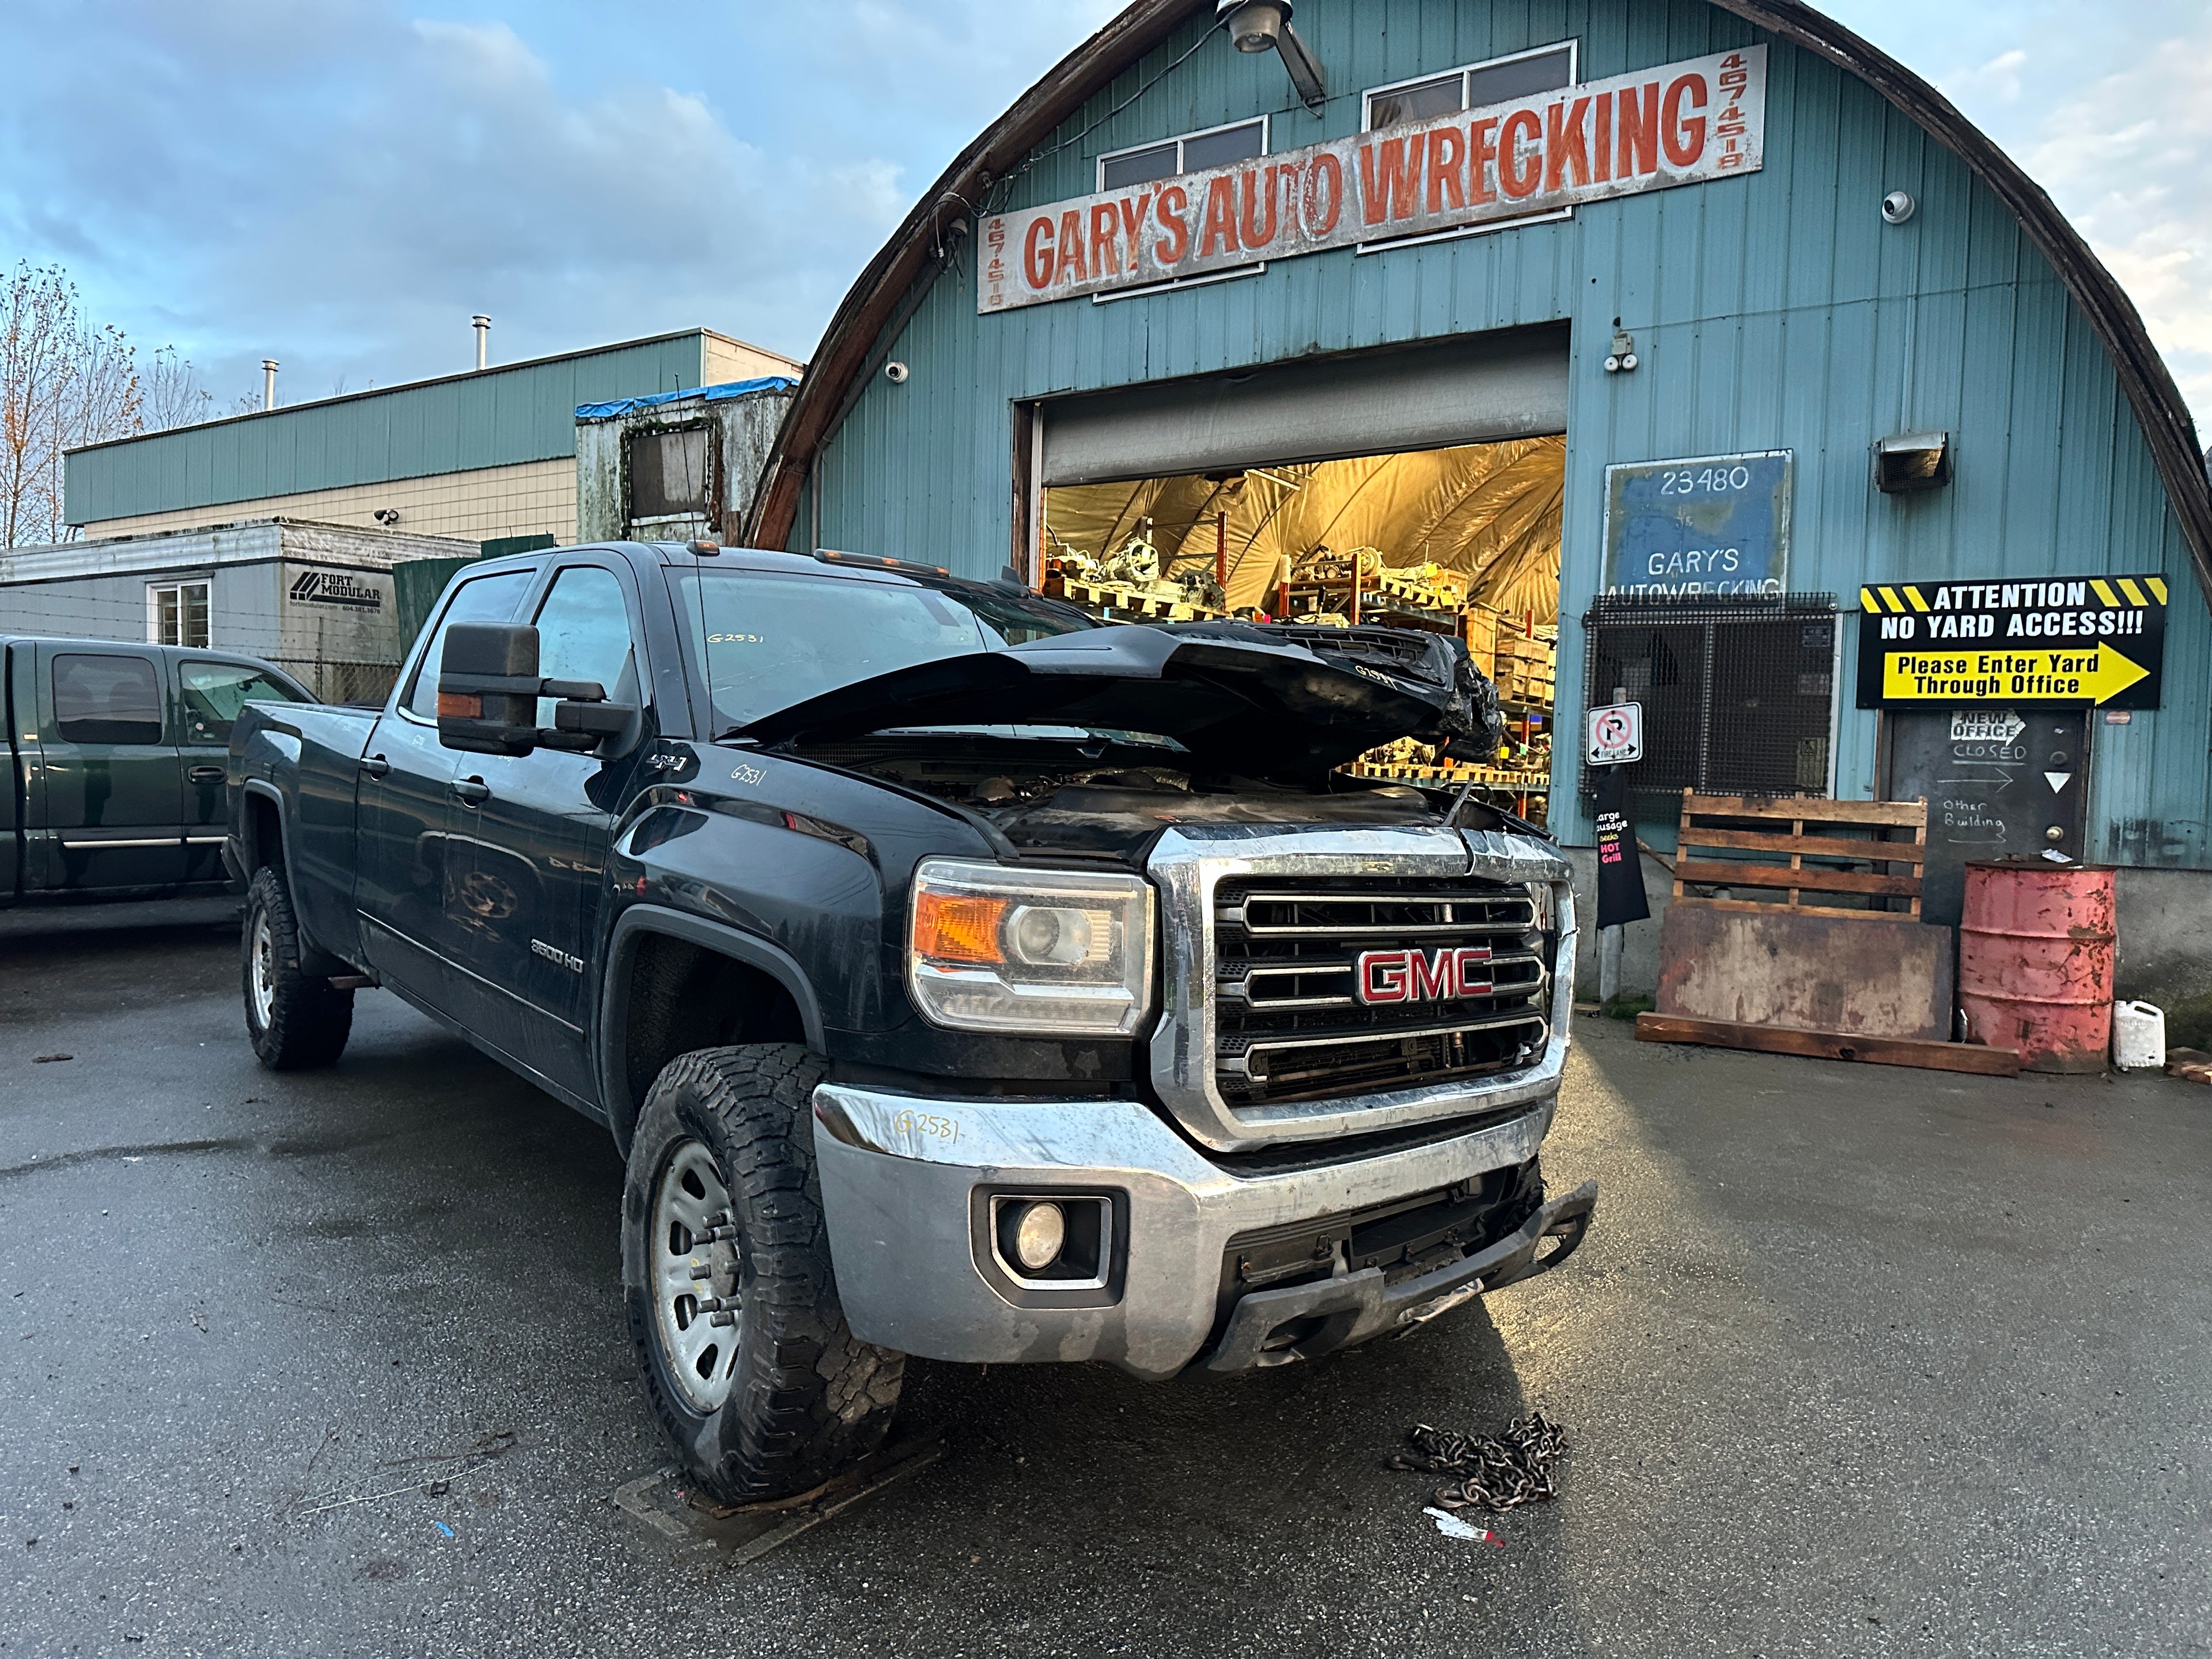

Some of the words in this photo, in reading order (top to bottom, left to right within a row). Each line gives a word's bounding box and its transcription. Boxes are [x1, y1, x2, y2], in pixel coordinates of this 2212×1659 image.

[1024, 183, 1187, 290] GARY'S
[1200, 153, 1342, 257] AUTO
[1360, 73, 1708, 225] WRECKING
[1661, 466, 1749, 495] 23480
[1648, 548, 1739, 575] GARY'S
[321, 573, 353, 586] FORT
[321, 584, 381, 600] MODULAR
[1934, 582, 2085, 610] ATTENTION
[1881, 616, 1915, 639] NO
[1927, 614, 1994, 638] YARD
[2006, 610, 2143, 636] ACCESS!!!
[707, 634, 764, 643] G2531
[1898, 657, 1967, 674] Please
[1978, 655, 2037, 673] Enter
[2048, 654, 2099, 672] Yard
[1914, 676, 2001, 697] Through
[2012, 675, 2079, 694] Office
[1962, 712, 2006, 725] NEW
[1952, 723, 2017, 737] OFFICE
[1953, 744, 2027, 759] CLOSED
[1943, 800, 1987, 811] Other
[1597, 812, 1620, 823] arge
[1944, 812, 2005, 835] Building
[1599, 832, 1619, 842] seeks
[1600, 842, 1620, 853] HOT
[1601, 852, 1622, 864] Grill
[1358, 946, 1493, 1006] GMC
[895, 1109, 959, 1145] G2531
